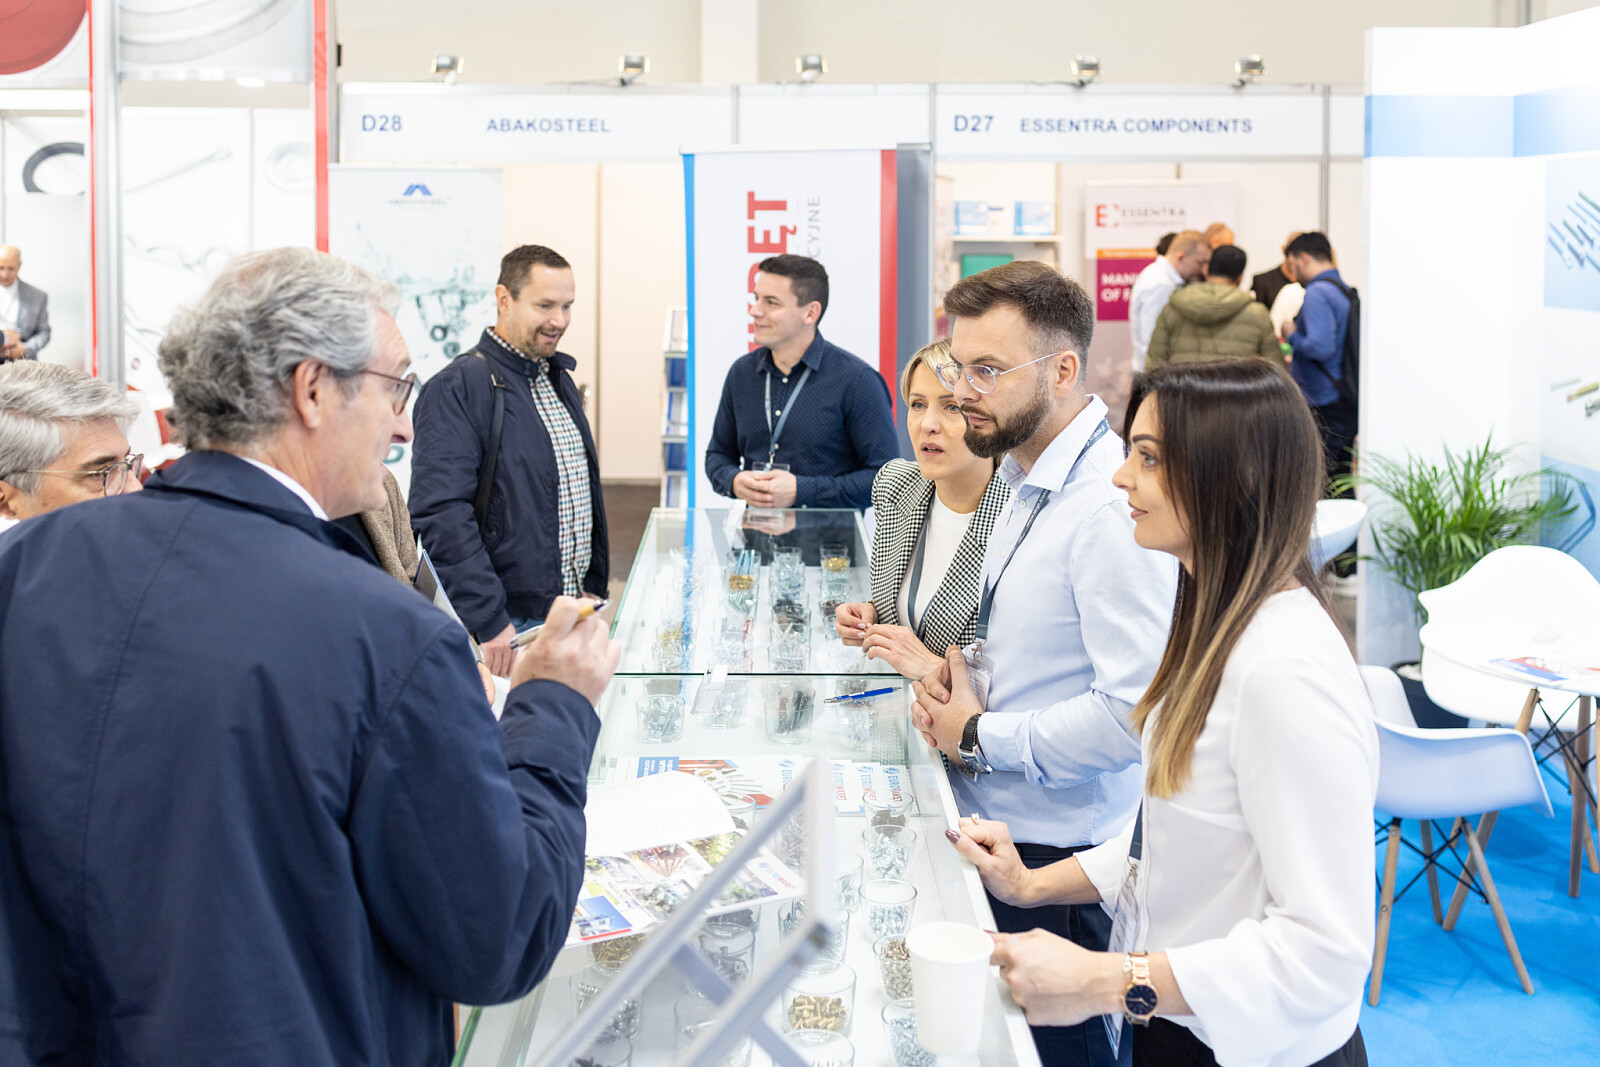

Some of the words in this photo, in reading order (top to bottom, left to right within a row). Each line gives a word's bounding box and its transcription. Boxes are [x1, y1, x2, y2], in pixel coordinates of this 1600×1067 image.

[361, 114, 402, 132] D28
[486, 118, 611, 133] ABAKOSTEEL
[953, 115, 994, 132] D27
[1020, 118, 1118, 133] ESSENTRA
[1123, 118, 1253, 133] COMPONENTS
